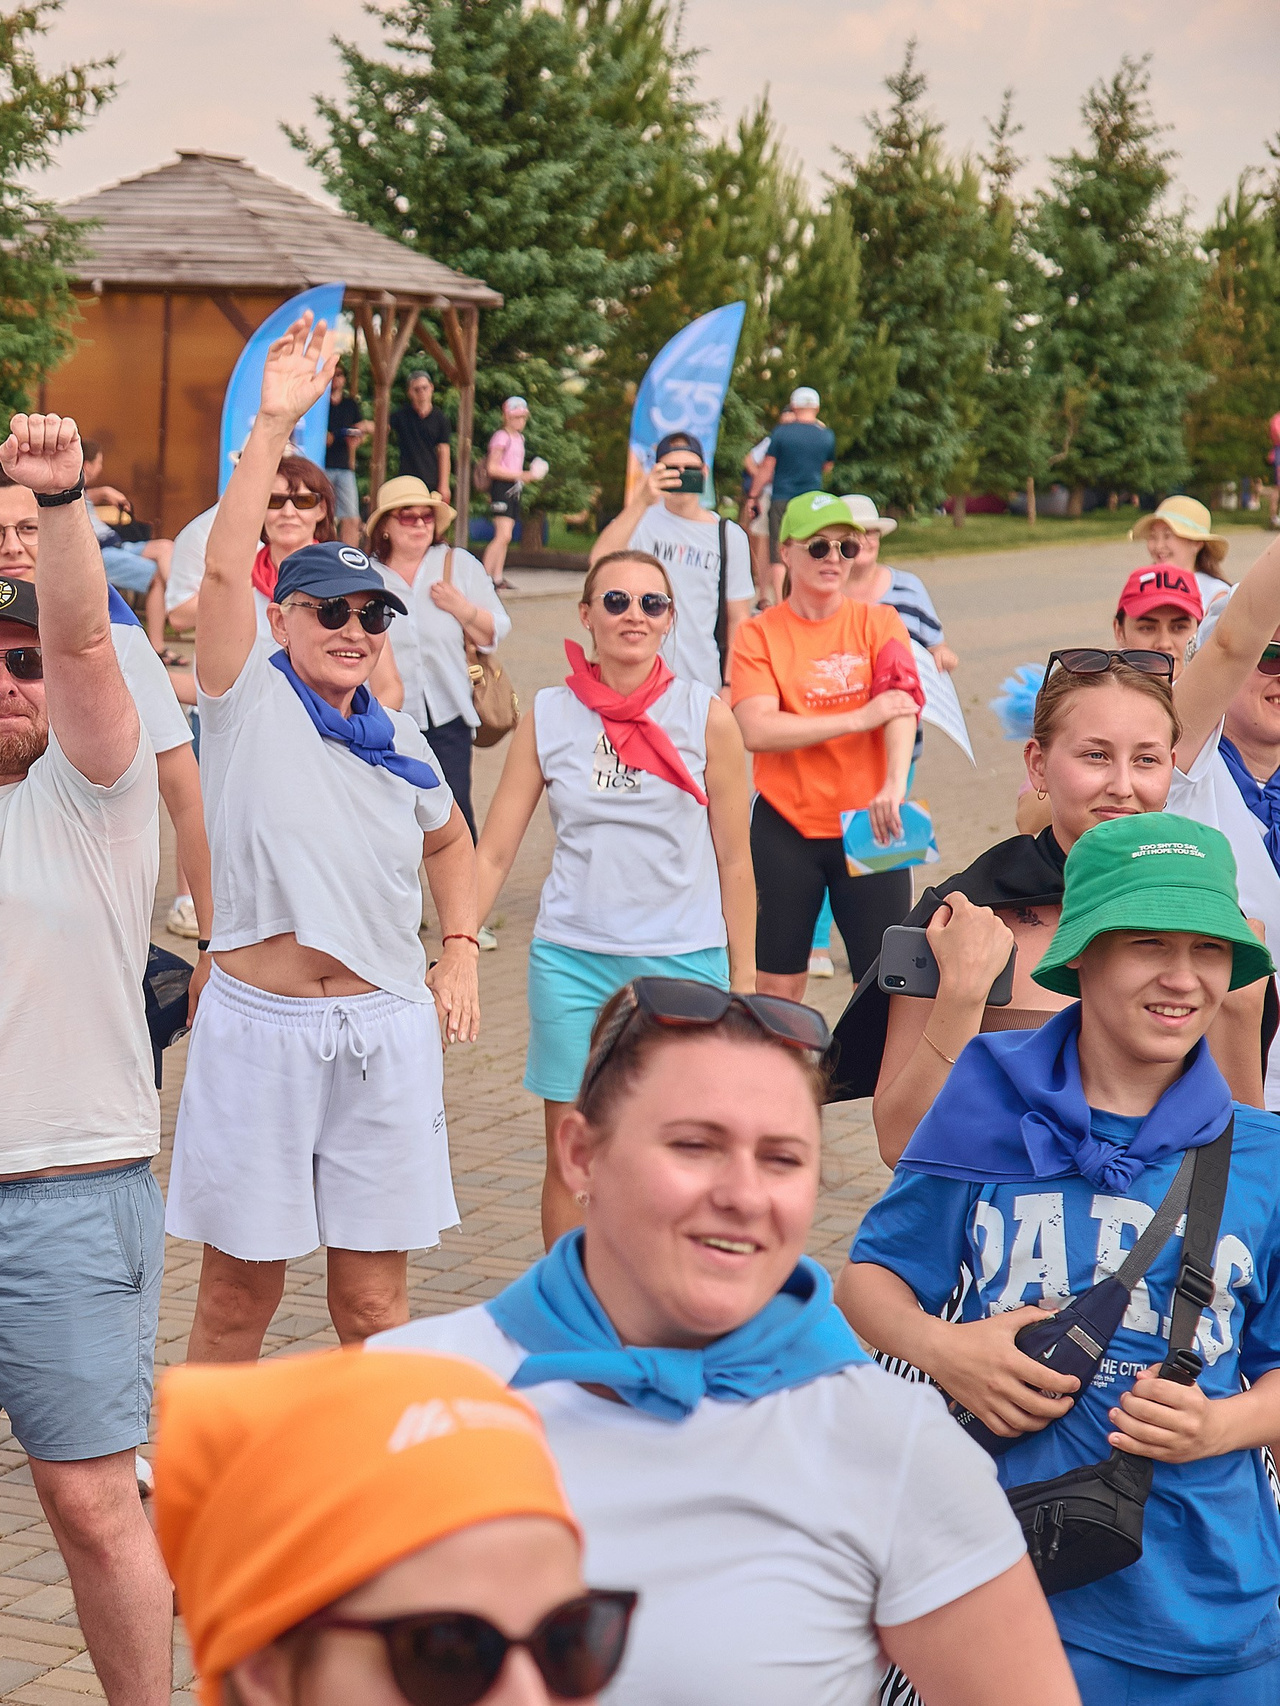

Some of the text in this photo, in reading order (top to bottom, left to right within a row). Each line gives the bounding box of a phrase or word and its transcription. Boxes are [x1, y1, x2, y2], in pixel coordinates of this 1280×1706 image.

[651, 380, 722, 431] 35
[1139, 572, 1189, 593] FILA
[975, 1192, 1253, 1366] PARS
